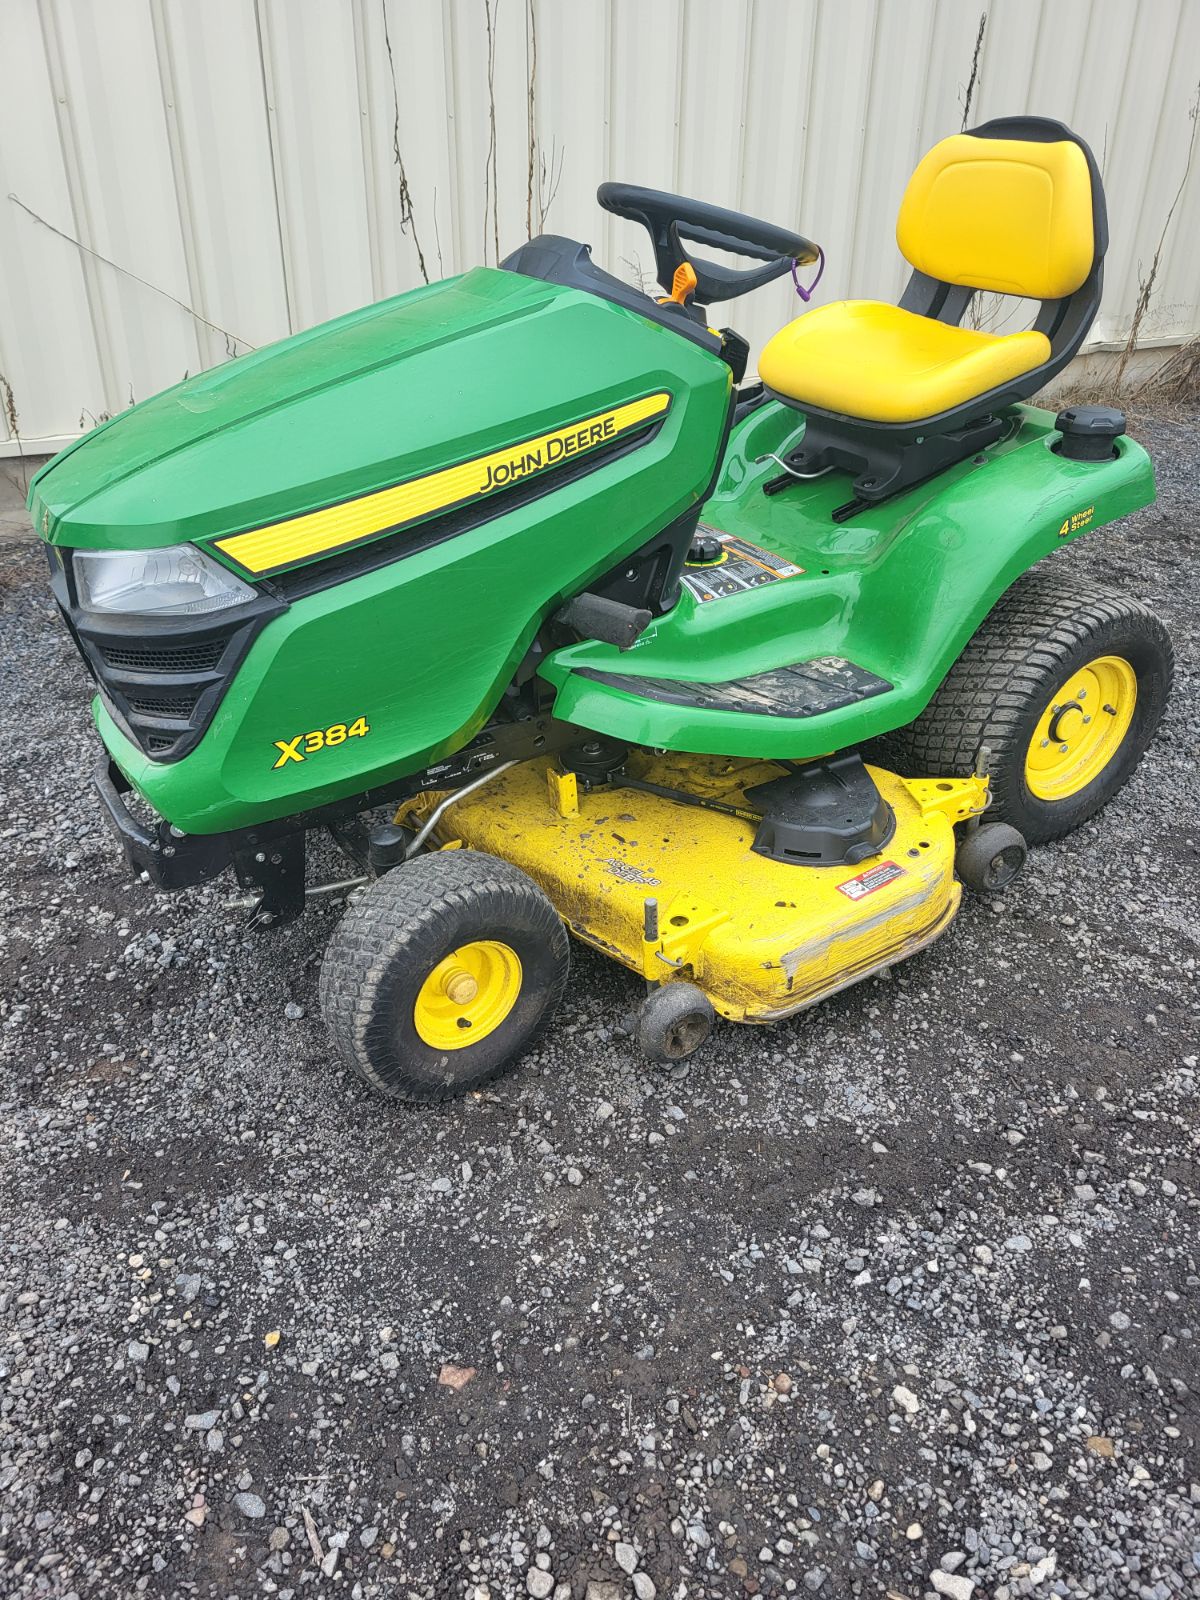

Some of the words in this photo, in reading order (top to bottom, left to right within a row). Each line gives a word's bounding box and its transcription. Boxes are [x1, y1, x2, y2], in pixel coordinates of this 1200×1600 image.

[480, 449, 542, 491] JOHN
[546, 416, 616, 462] DEERE
[1059, 519, 1070, 536] 4
[1071, 505, 1095, 523] Wheel
[1070, 515, 1093, 532] Steer
[272, 716, 370, 770] X384
